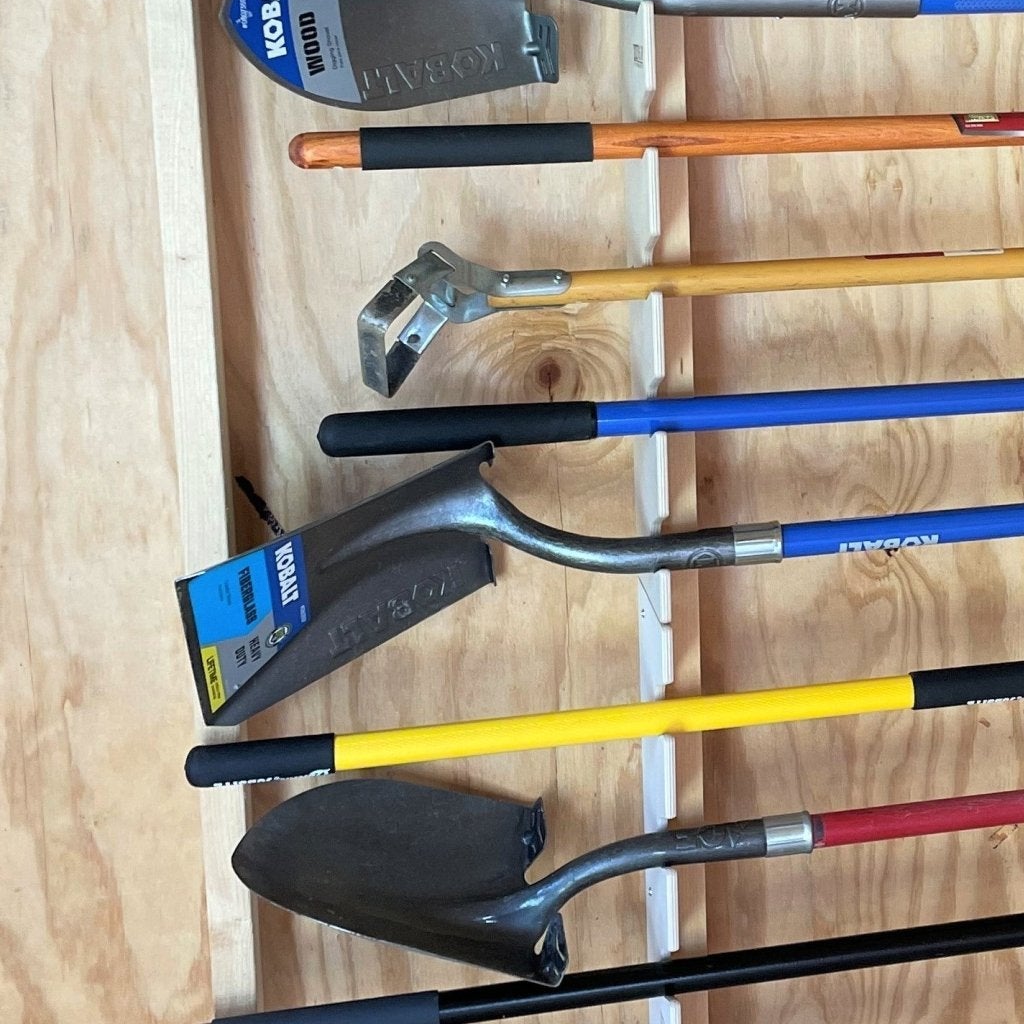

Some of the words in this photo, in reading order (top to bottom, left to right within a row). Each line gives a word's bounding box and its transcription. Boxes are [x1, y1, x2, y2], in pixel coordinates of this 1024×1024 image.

[298, 11, 326, 77] WOOD
[362, 40, 507, 101] KOBALT
[238, 566, 258, 626] FIBERGLASS
[274, 541, 300, 608] KOBALT
[206, 656, 218, 684] LIFETIME
[234, 645, 247, 668] DUTY
[249, 636, 262, 663] HEAVY
